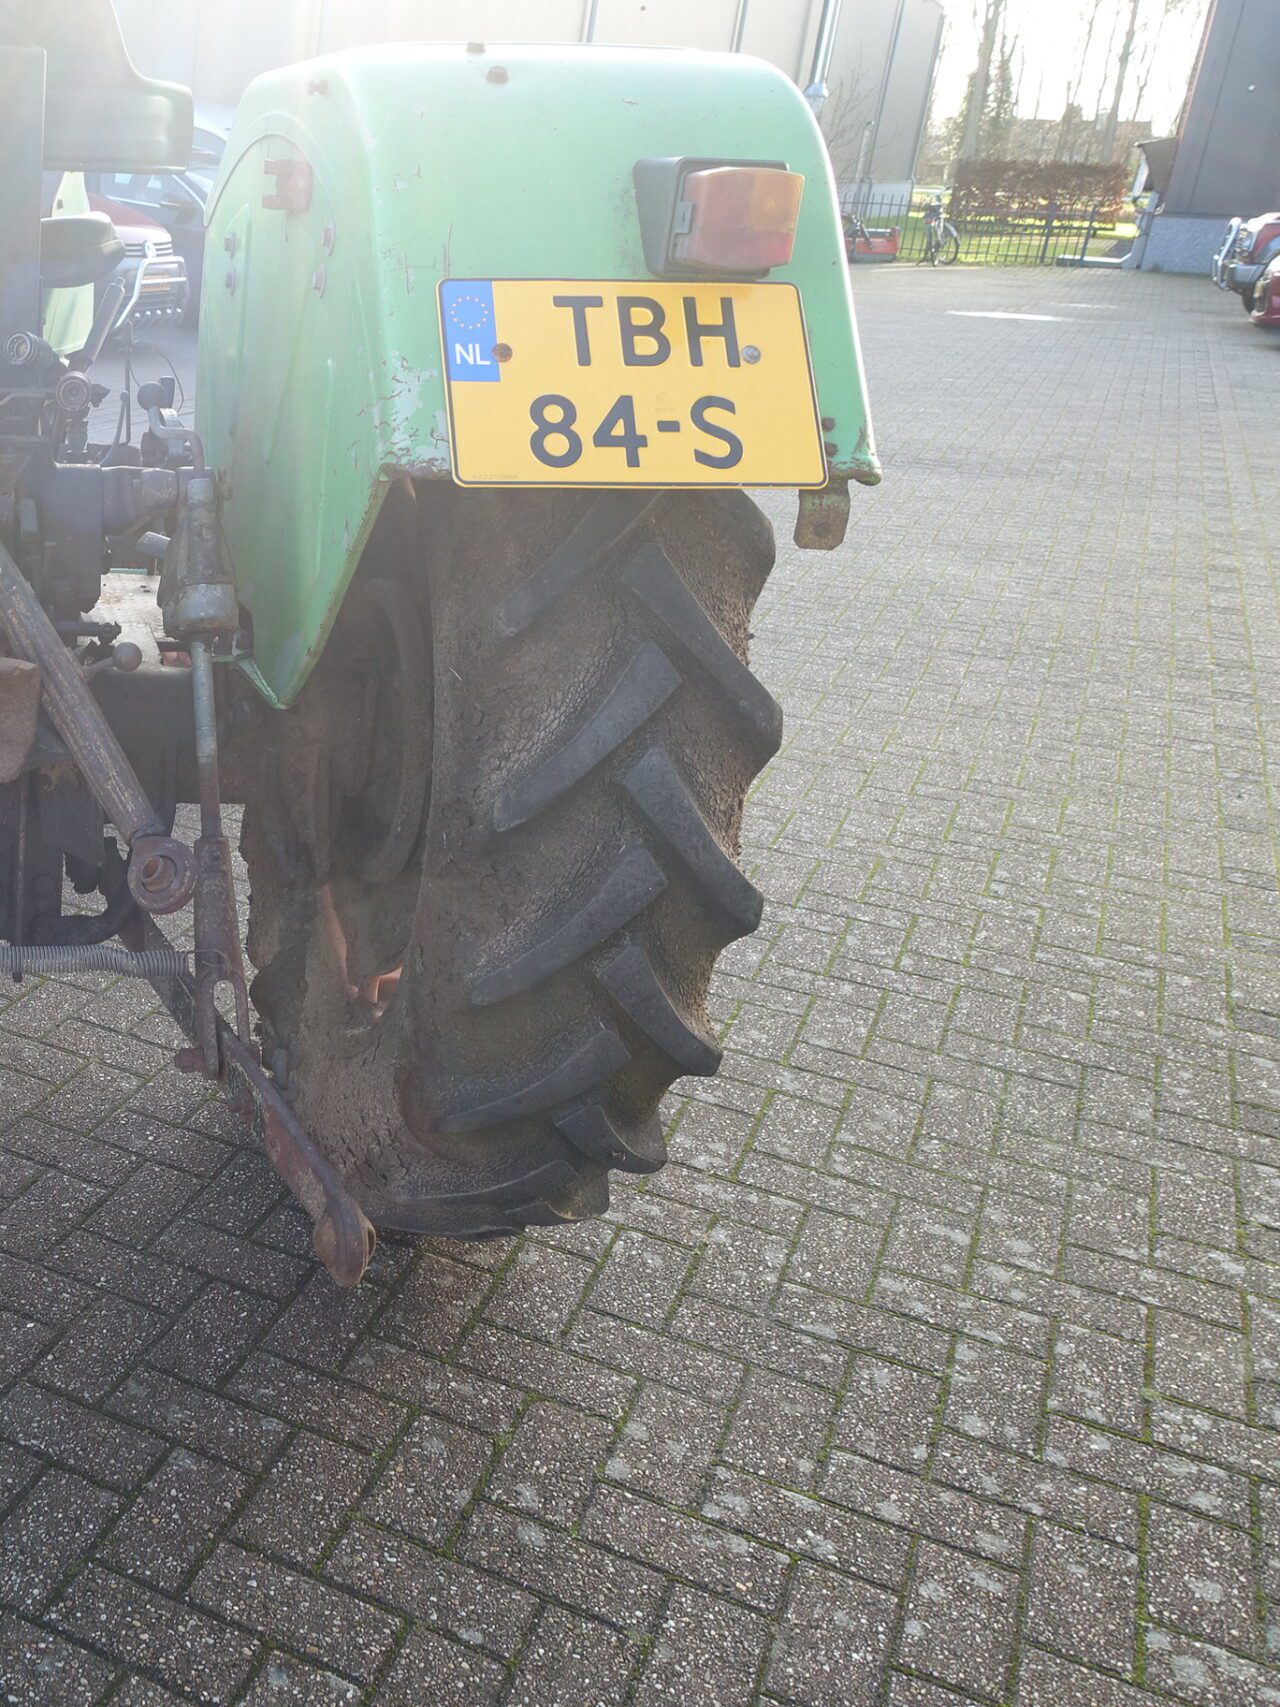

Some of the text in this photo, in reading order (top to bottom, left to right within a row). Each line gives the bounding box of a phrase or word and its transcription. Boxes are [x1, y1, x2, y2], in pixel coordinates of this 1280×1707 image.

[455, 343, 491, 366] NL
[552, 295, 742, 368] TBH
[529, 393, 744, 470] 84-S
